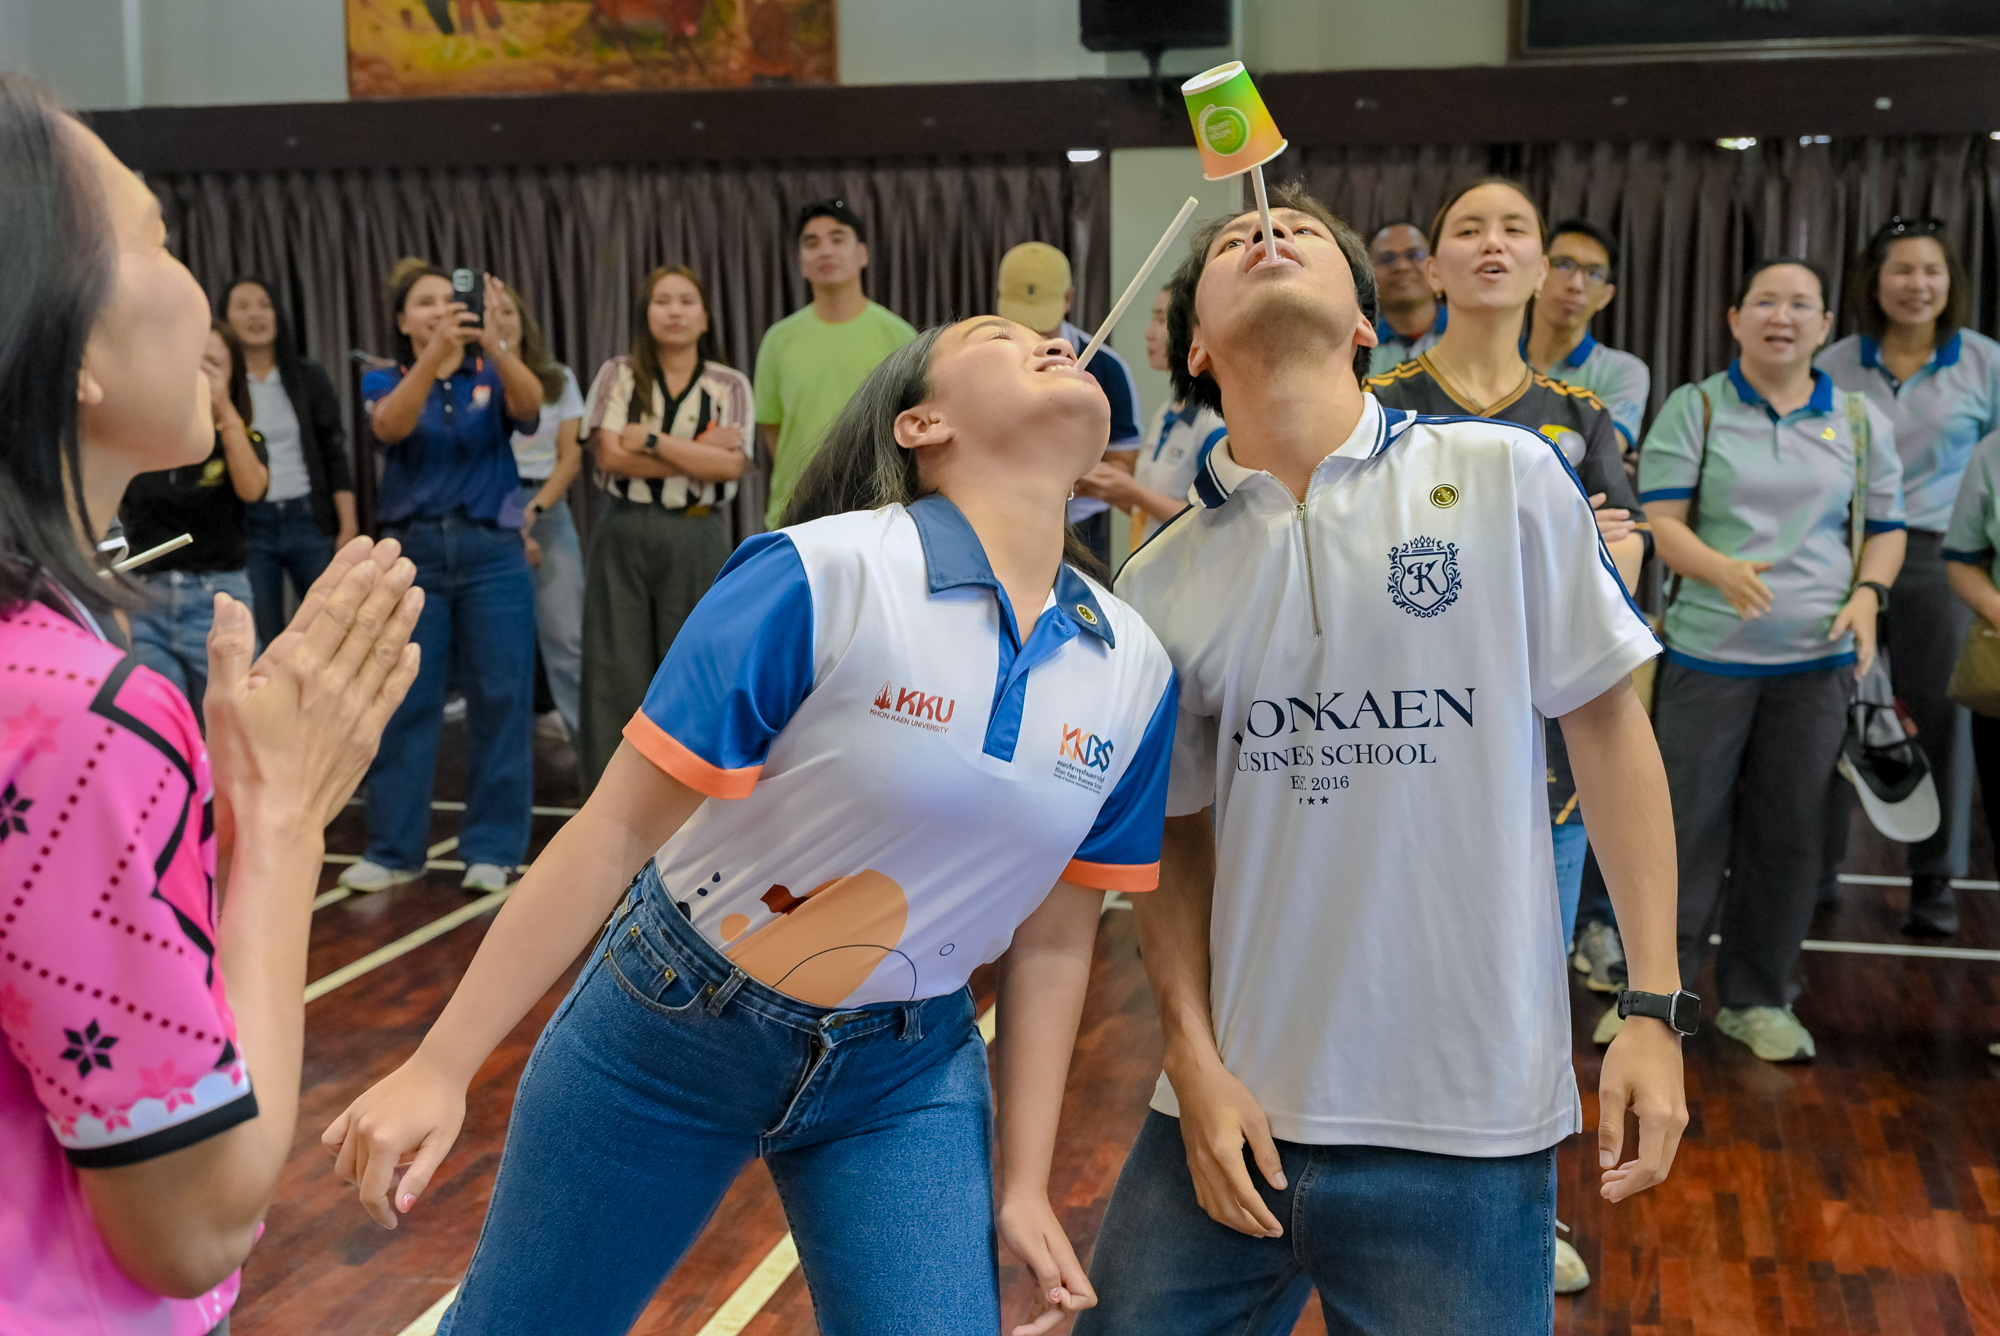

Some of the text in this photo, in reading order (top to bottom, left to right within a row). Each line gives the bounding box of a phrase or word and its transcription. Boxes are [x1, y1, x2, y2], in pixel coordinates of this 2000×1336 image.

[1407, 560, 1448, 596] K
[895, 687, 955, 723] KKU
[1232, 687, 1476, 747] ONKAEN
[869, 708, 949, 734] KHON KAEN UNIVERSITY
[1321, 743, 1437, 766] SCHOOL
[1311, 775, 1350, 791] 2016
